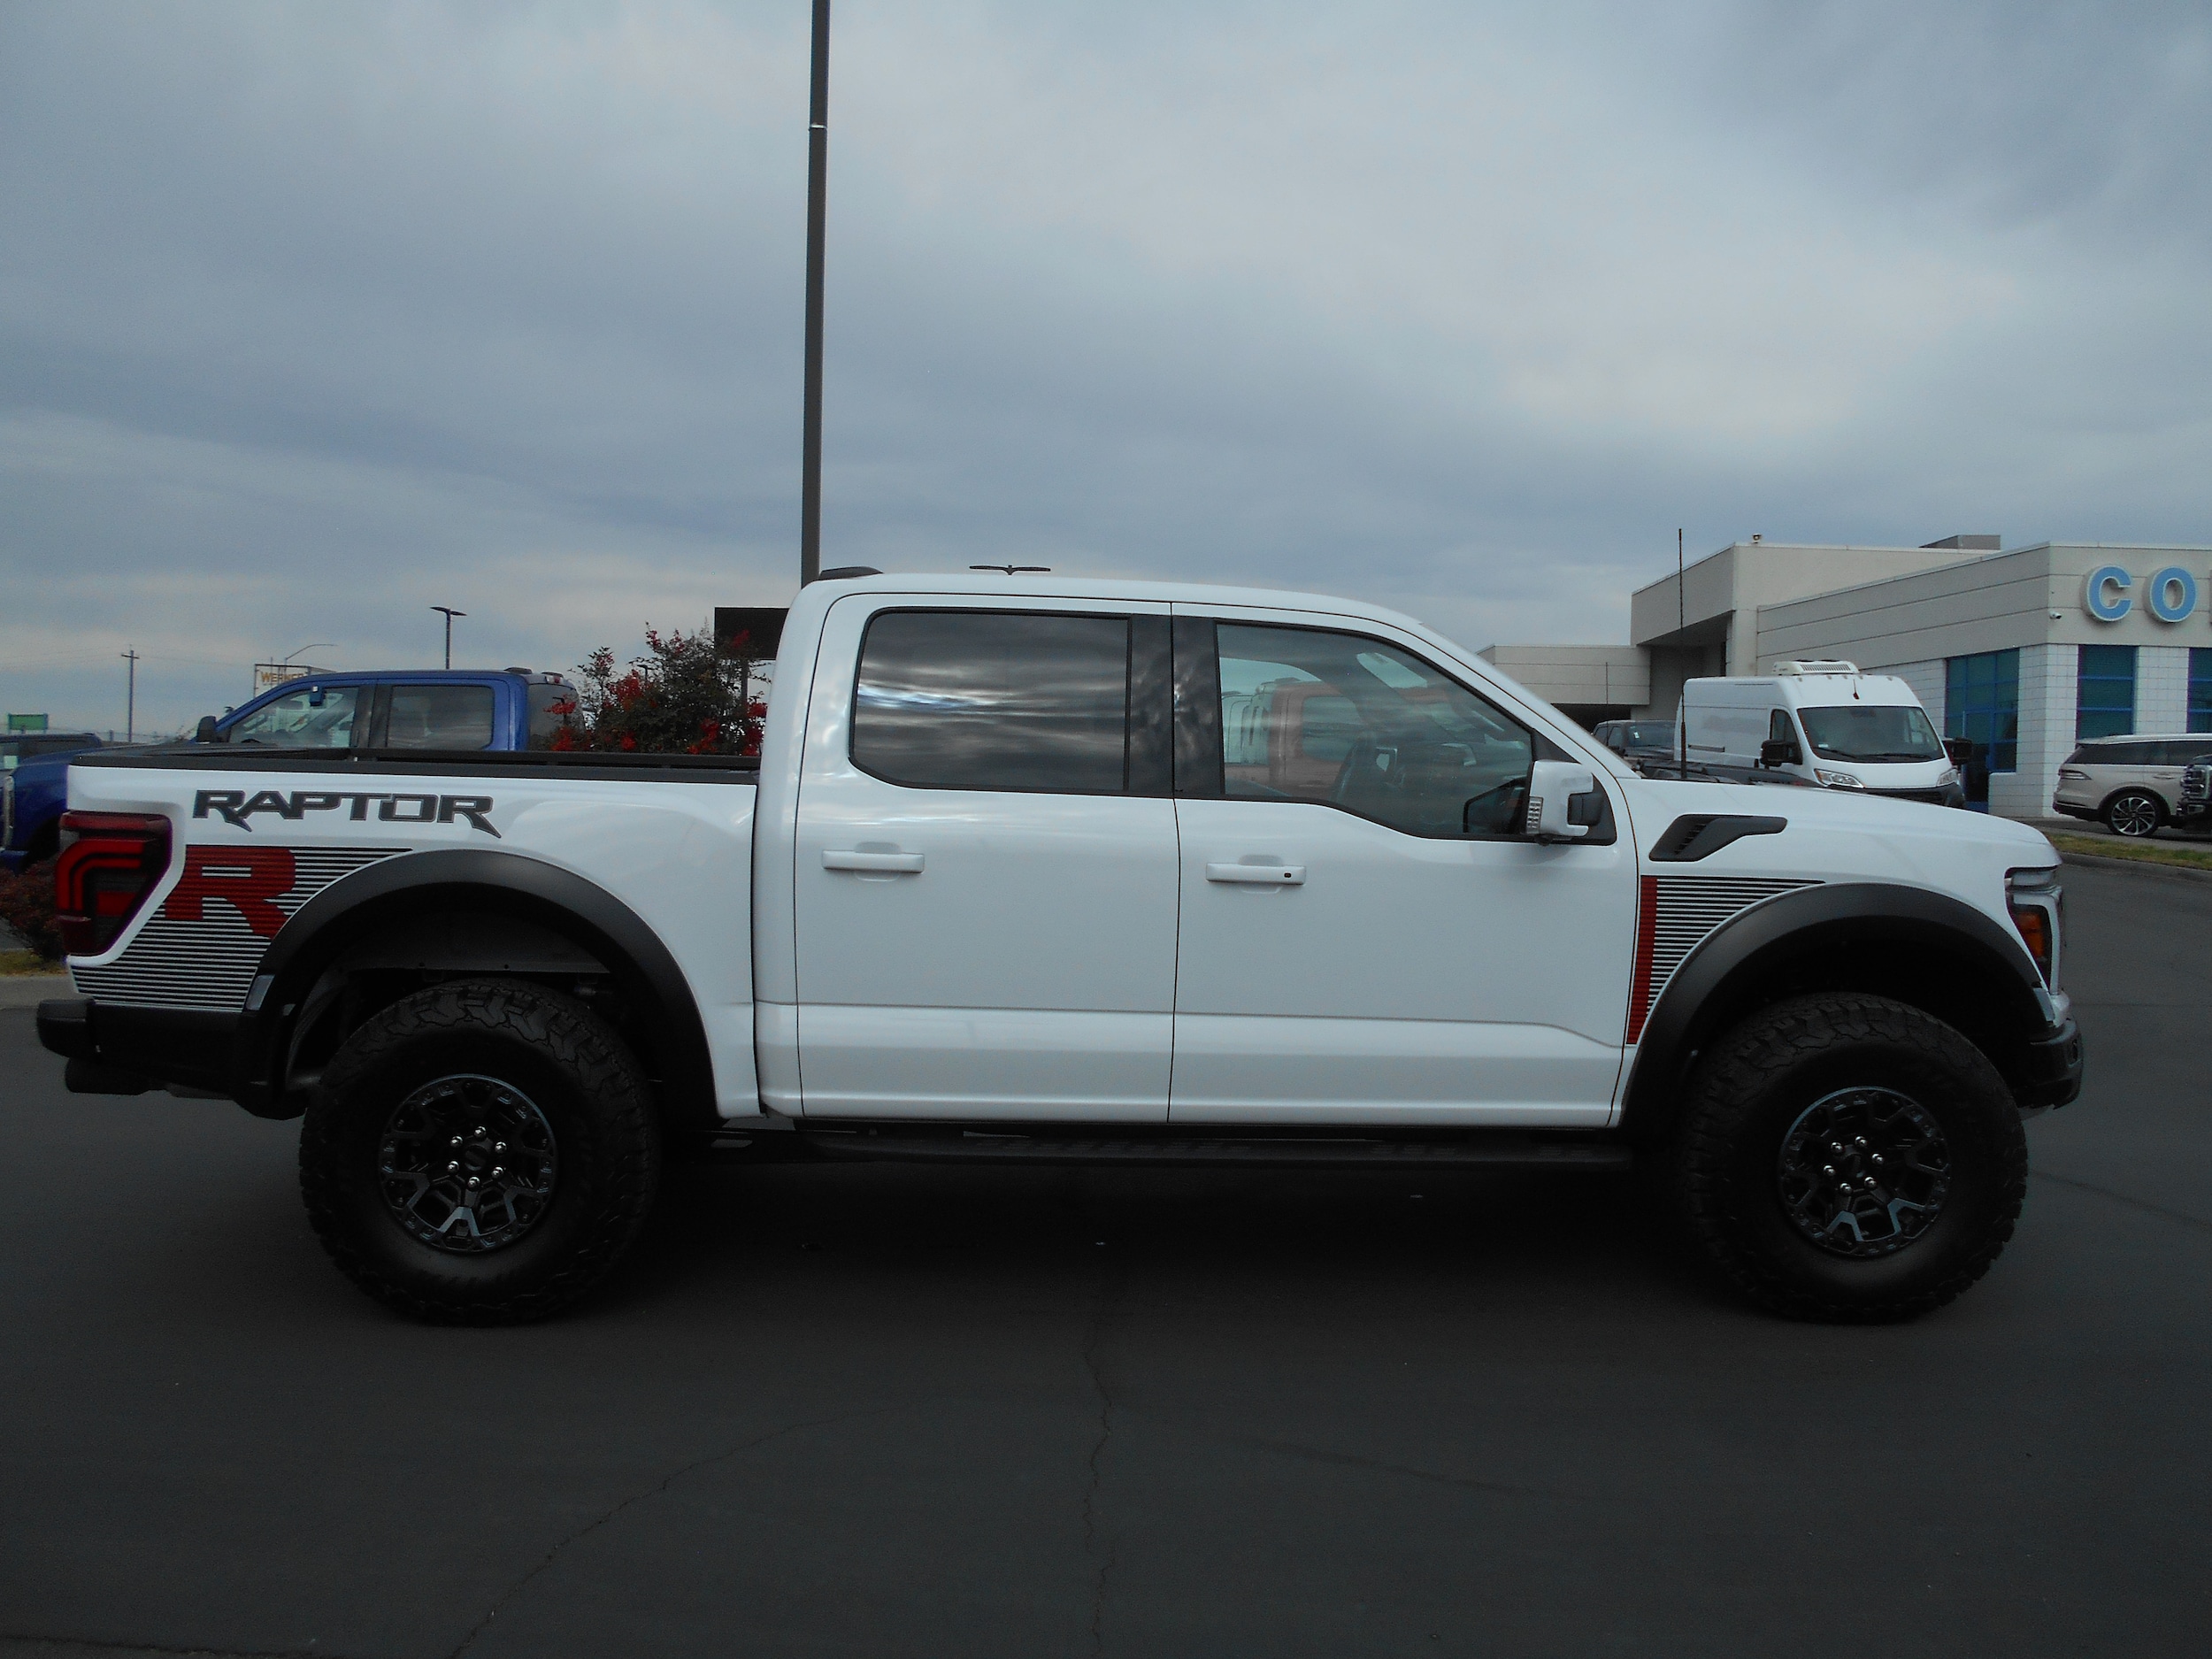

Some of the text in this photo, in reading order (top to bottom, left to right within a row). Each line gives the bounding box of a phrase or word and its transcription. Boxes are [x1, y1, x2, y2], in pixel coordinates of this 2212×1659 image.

[2083, 565, 2212, 623] CO
[193, 789, 502, 839] RAPTOR
[165, 844, 296, 941] R
